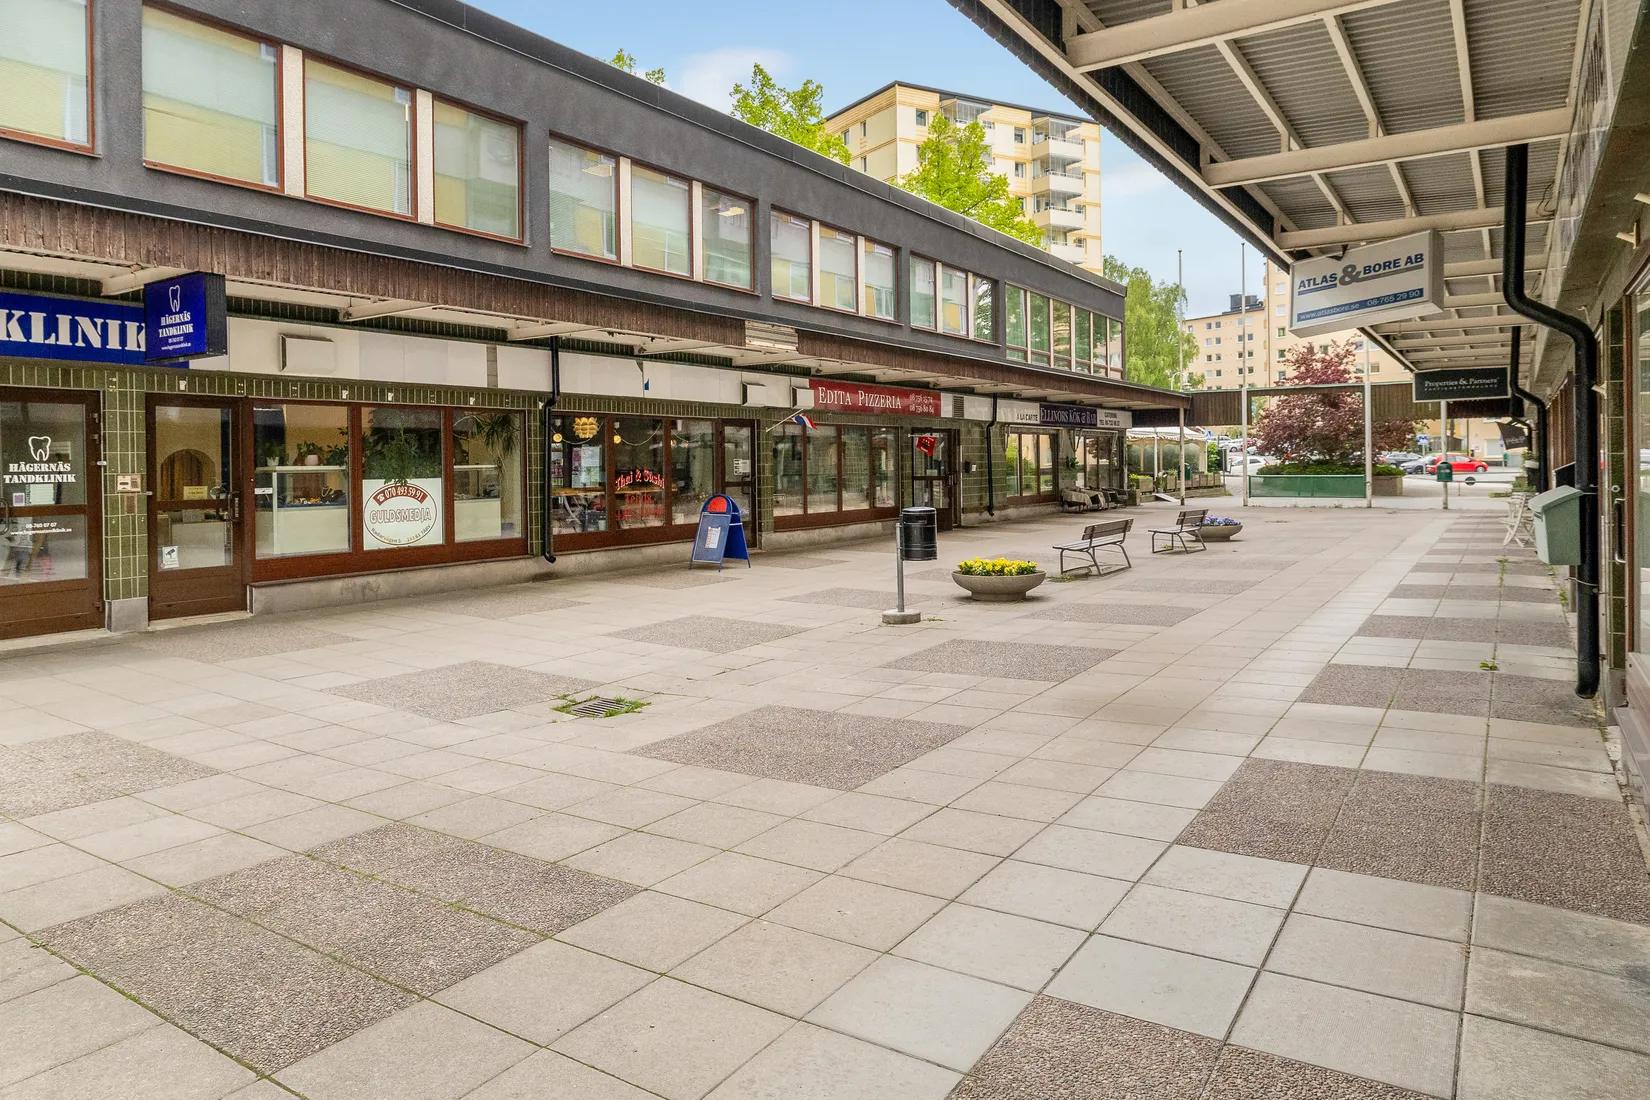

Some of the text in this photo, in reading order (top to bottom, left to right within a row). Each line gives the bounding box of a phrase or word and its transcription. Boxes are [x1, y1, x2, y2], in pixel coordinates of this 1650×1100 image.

[1298, 273, 1337, 290] ATLAS
[1338, 264, 1362, 286] &
[1363, 258, 1401, 275] BORE
[1404, 253, 1424, 266] AB
[1300, 289, 1420, 320] www.atlasbore.se 08-765 29 90
[160, 311, 191, 326] HÄGERNÄS
[0, 309, 146, 352] KLINIK
[158, 324, 194, 337] TANDKLINIK
[1424, 380, 1458, 388] Properties
[818, 387, 902, 409] EDITA PIZZERIA
[1040, 408, 1068, 422] ELLINORS
[1086, 412, 1097, 425] BAR
[9, 462, 71, 472] HÄGERNÄS
[3, 474, 76, 483] TANDKLINIK
[636, 469, 642, 482] &
[385, 486, 423, 500] 070 493 59 91
[370, 508, 431, 524] GULDSMEDJA
